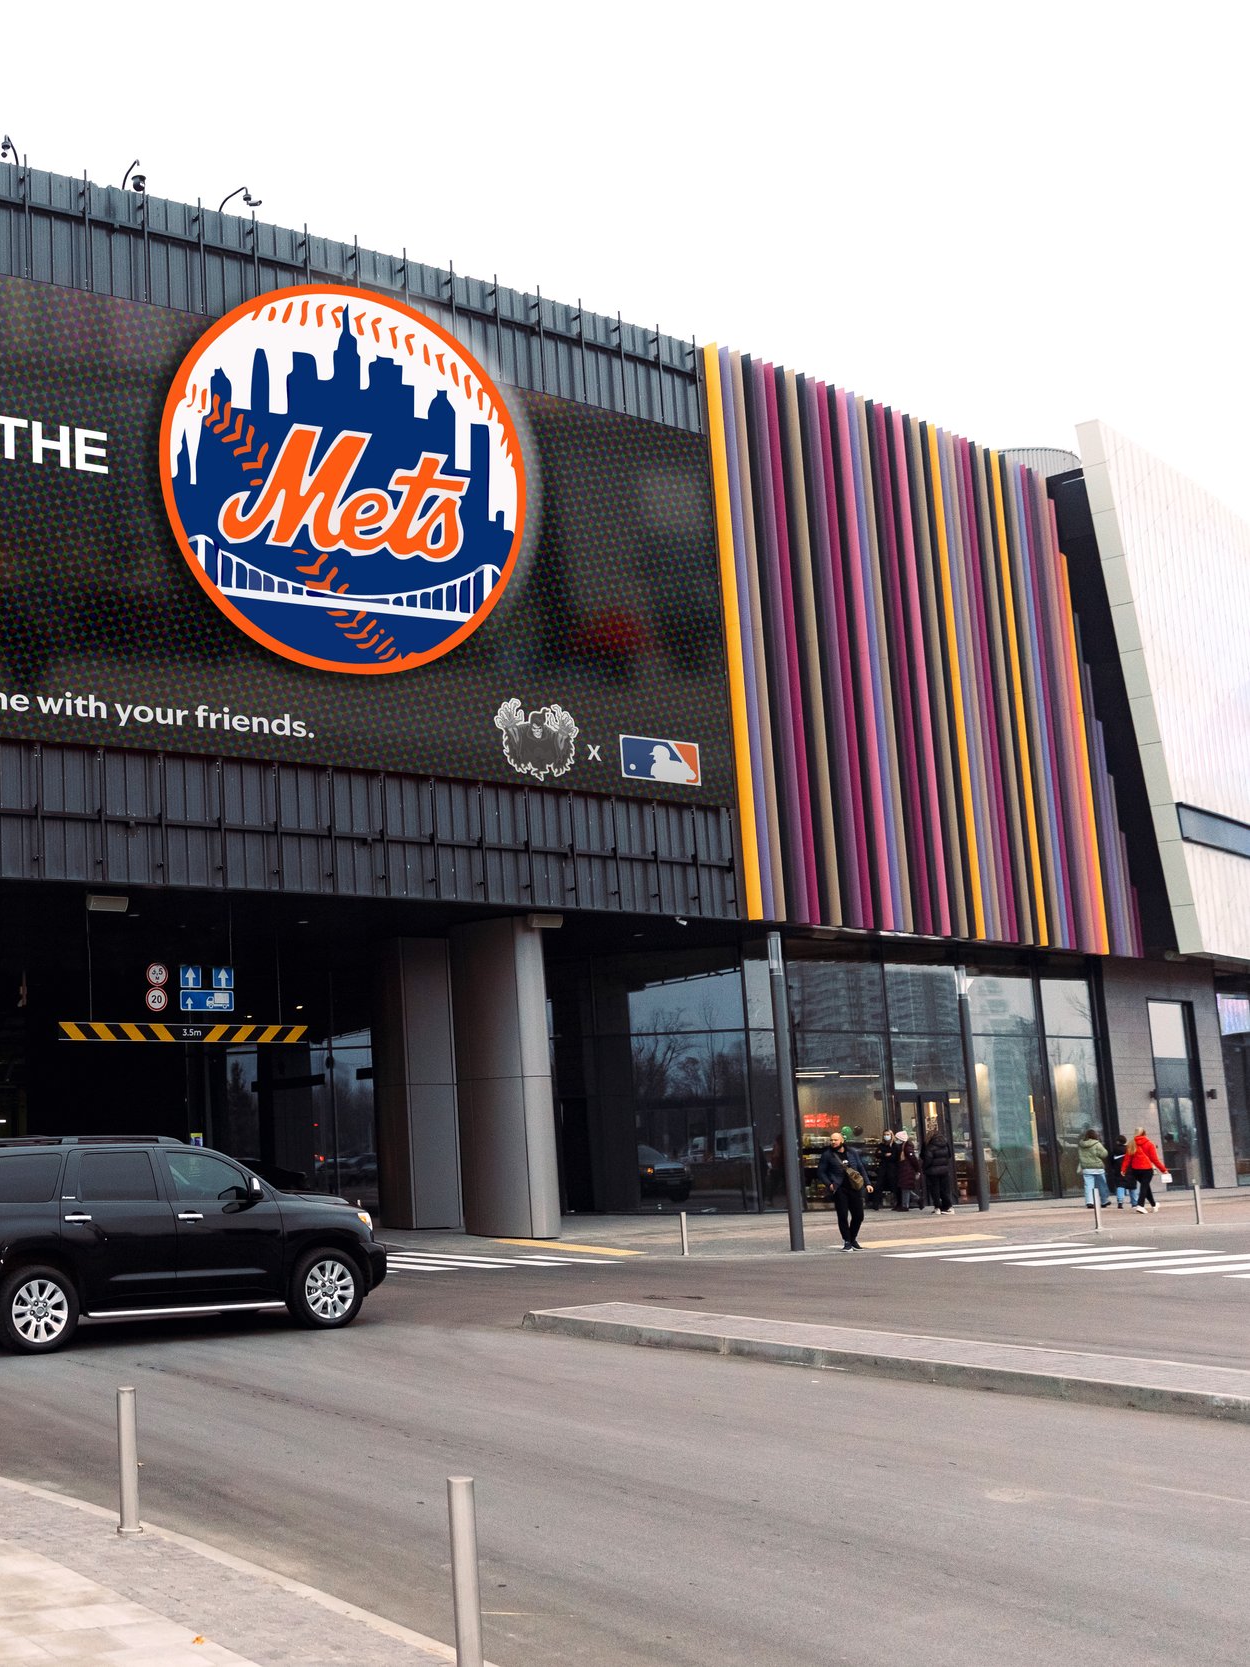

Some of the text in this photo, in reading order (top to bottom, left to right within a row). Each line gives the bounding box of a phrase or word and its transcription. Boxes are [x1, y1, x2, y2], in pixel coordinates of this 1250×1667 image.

[217, 423, 471, 563] Mets
[36, 691, 107, 719] with
[114, 703, 189, 727] your
[194, 704, 315, 739] friends.
[151, 995, 163, 1004] 20
[182, 1028, 202, 1037] 3.5m
